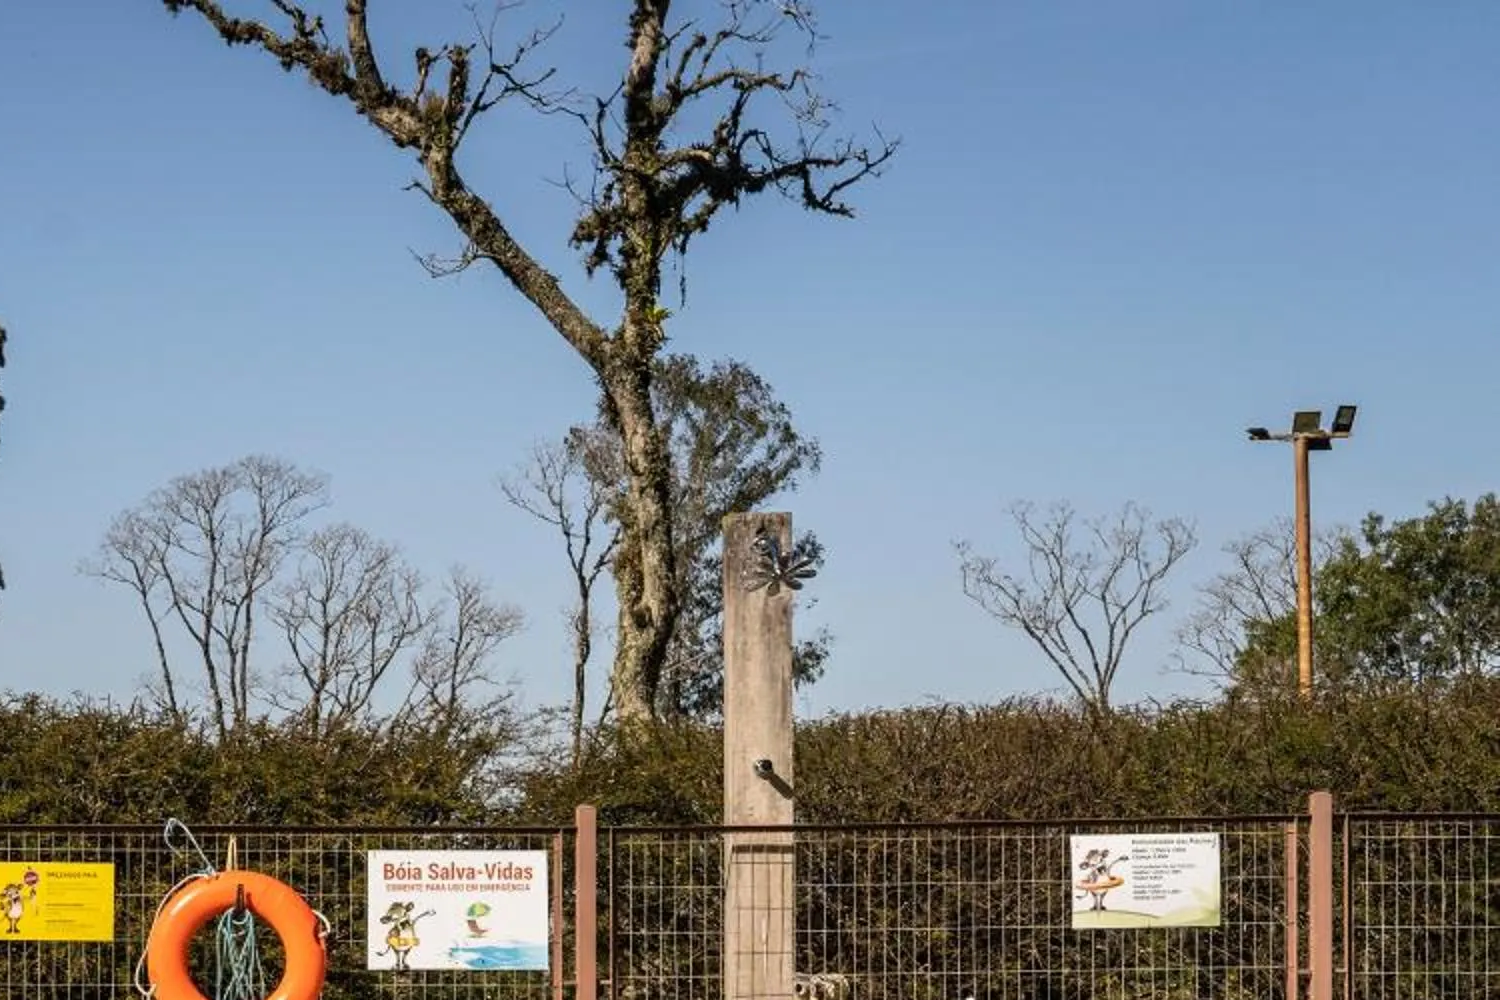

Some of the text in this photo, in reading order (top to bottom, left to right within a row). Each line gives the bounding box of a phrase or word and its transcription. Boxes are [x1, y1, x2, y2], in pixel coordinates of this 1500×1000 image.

[383, 861, 533, 880] Bóia Salva-Vidas
[425, 883, 446, 892] PARA
[465, 883, 479, 892] EM
[479, 882, 531, 892] EMERGÊNCIA
